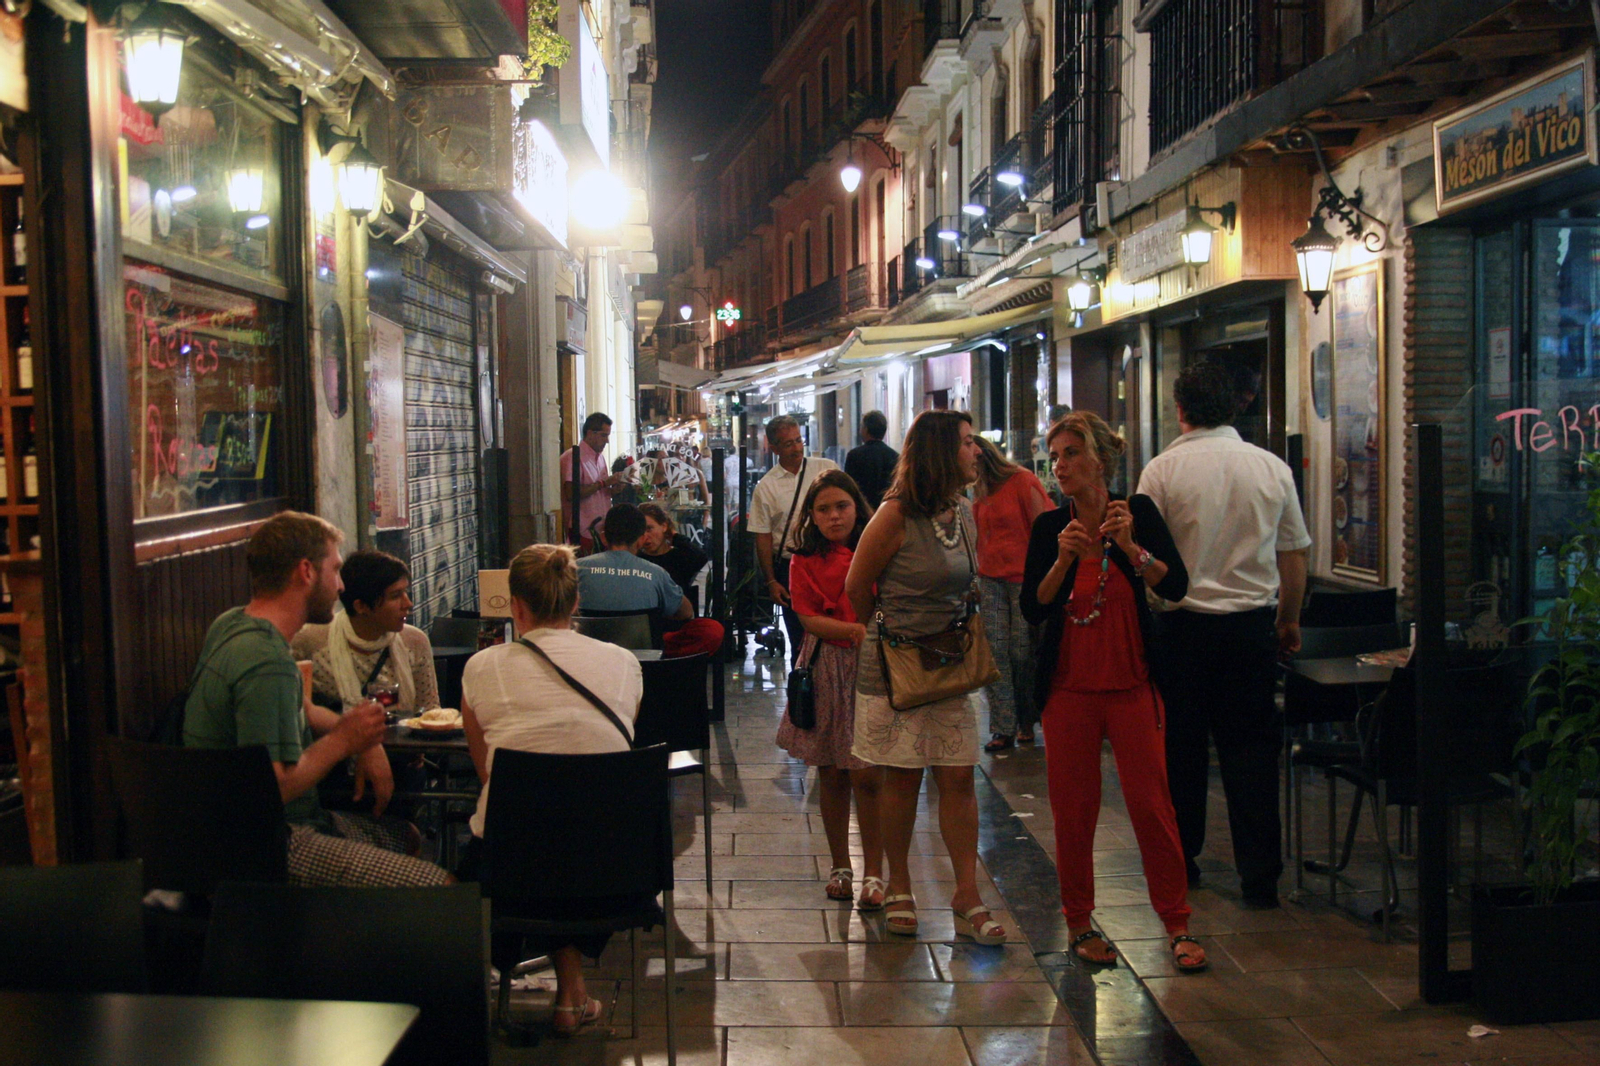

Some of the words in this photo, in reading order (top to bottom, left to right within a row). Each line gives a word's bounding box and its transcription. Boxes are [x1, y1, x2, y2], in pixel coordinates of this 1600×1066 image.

[402, 98, 482, 172] BAR
[1502, 124, 1531, 171] del
[1537, 114, 1581, 158] Vico
[590, 566, 607, 575] THIS
[608, 567, 615, 576] IS
[617, 568, 631, 577] THE
[632, 568, 652, 581] PLACE
